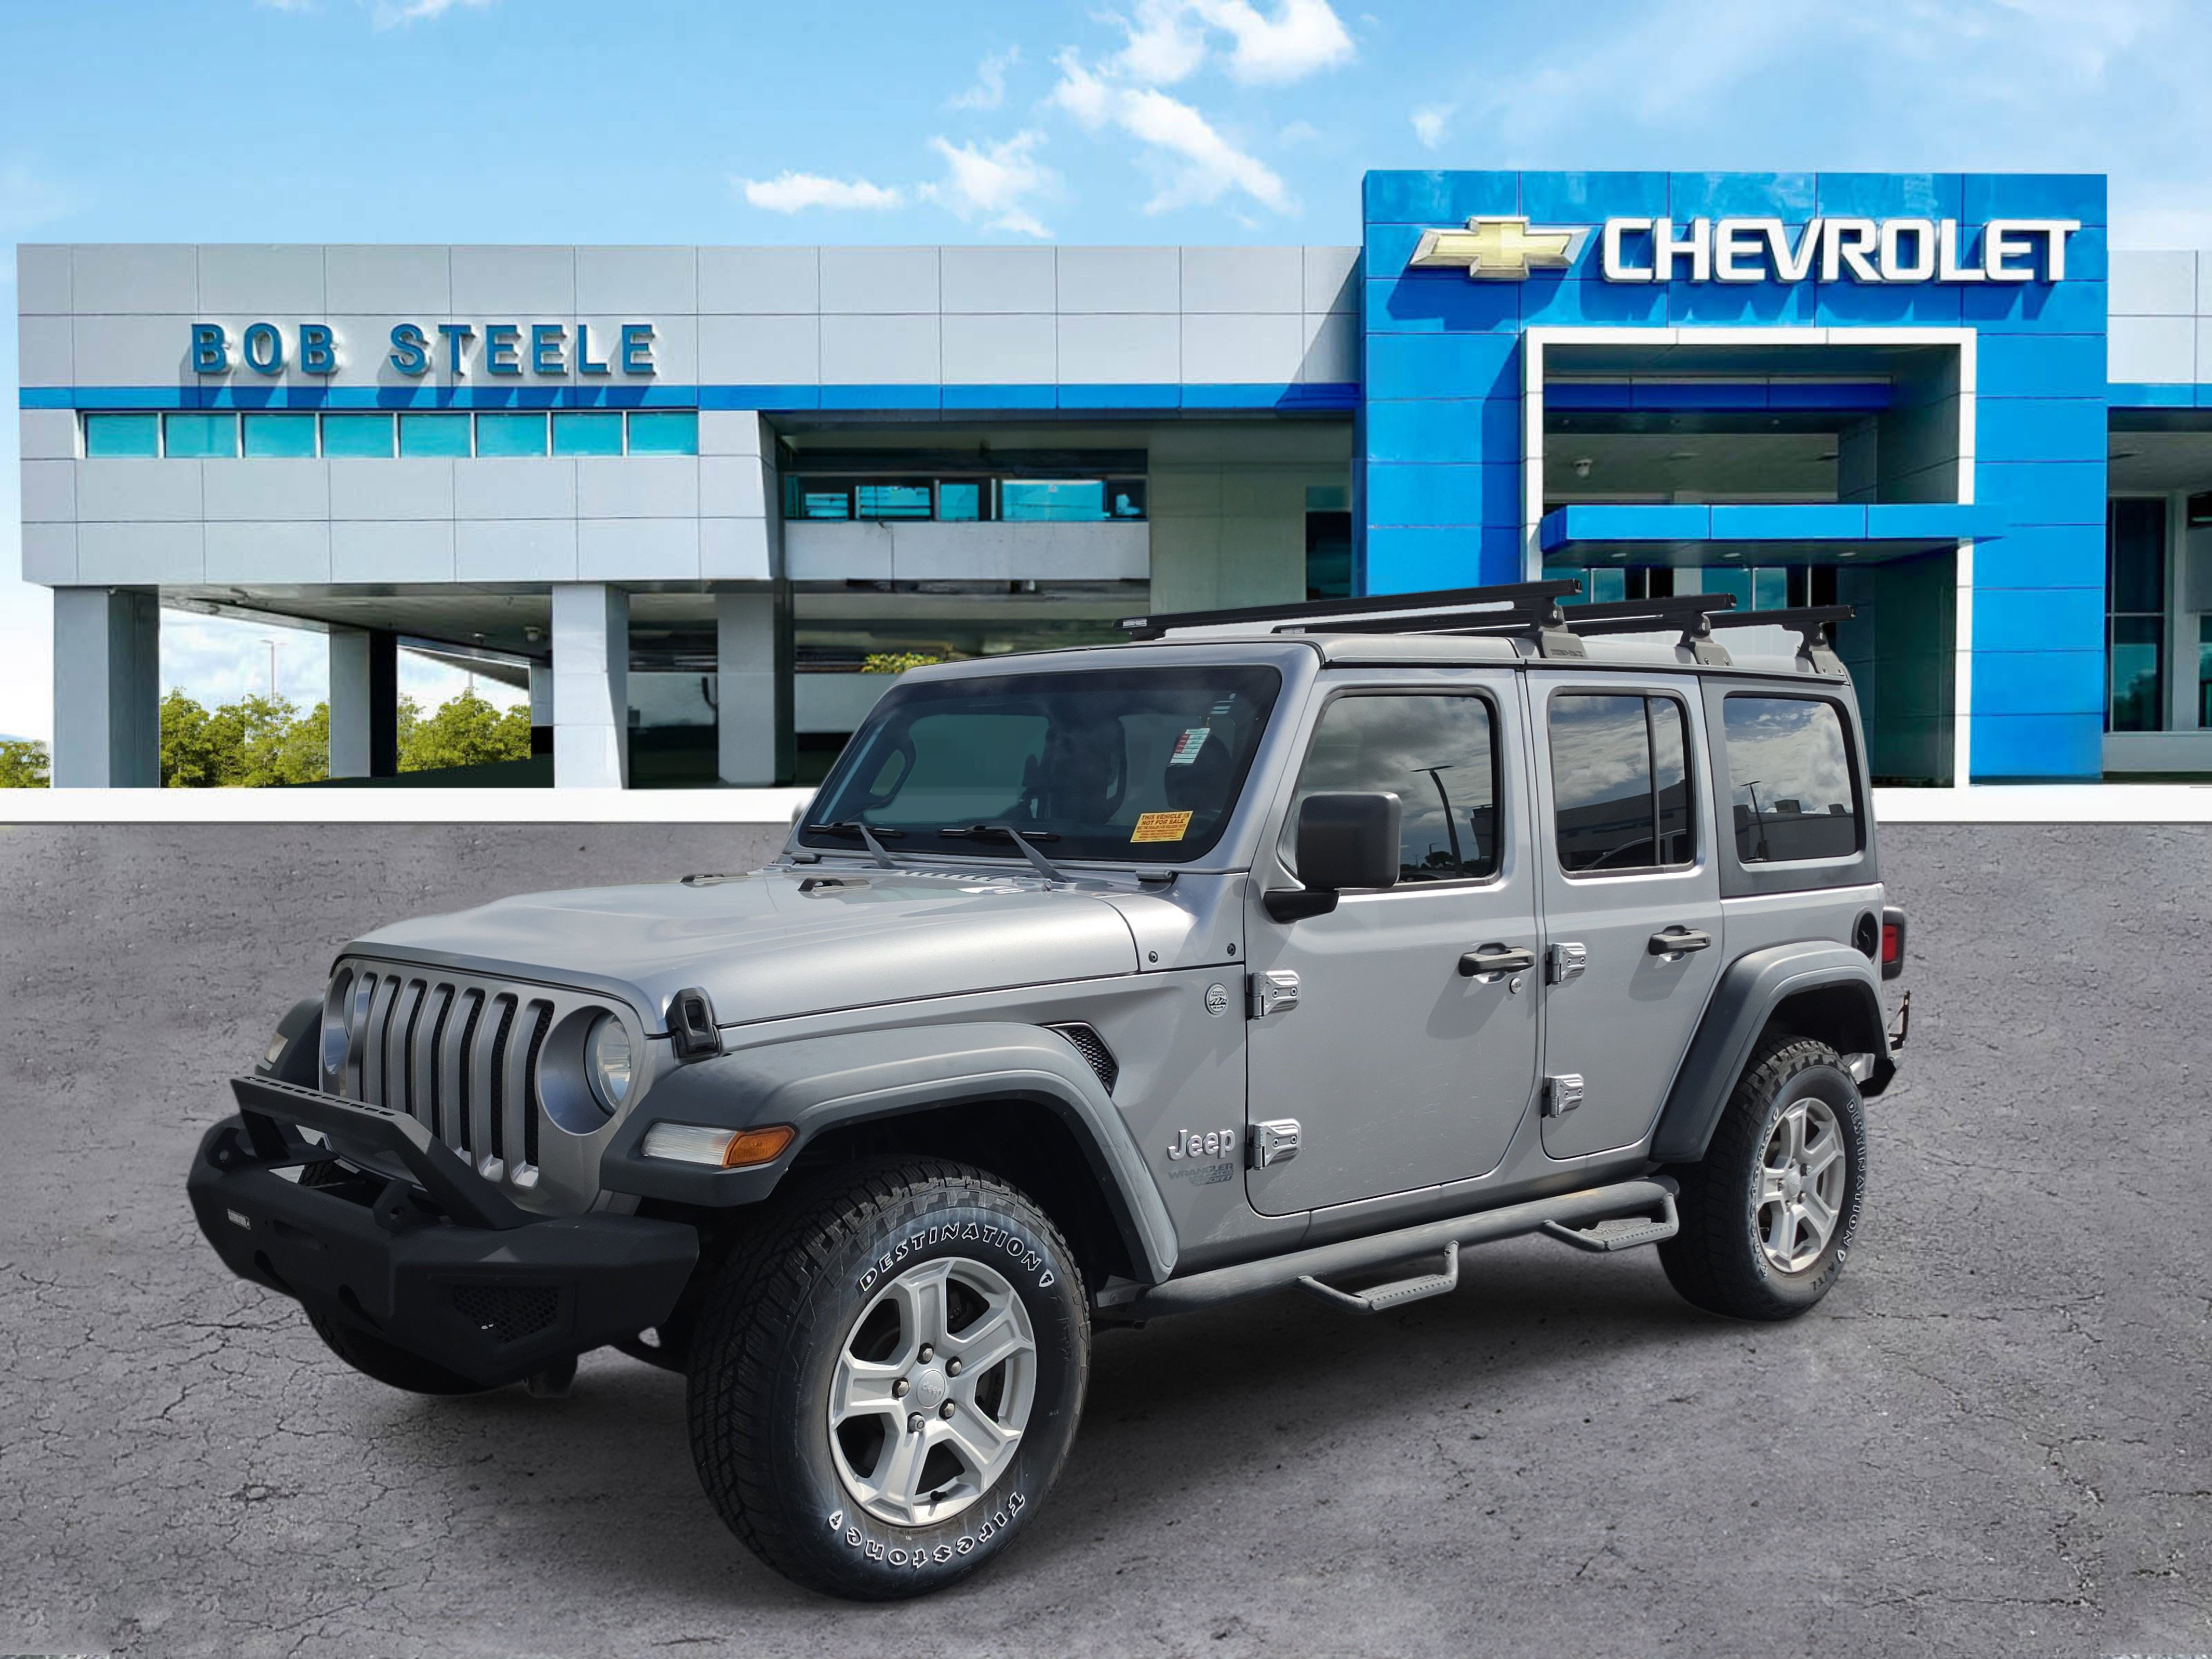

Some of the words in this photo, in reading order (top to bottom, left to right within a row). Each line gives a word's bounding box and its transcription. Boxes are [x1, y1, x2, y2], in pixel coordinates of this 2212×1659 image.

[1602, 218, 2081, 281] CHEVROLET
[191, 323, 338, 374] BOB
[389, 323, 655, 375] STEELE
[1167, 1162, 1234, 1180] WRANGLER
[1168, 1129, 1235, 1161] Jeep
[1844, 1098, 1866, 1247] DESTINATION
[858, 1221, 1042, 1291] DESTINATION
[847, 1492, 1025, 1569] Firestone
